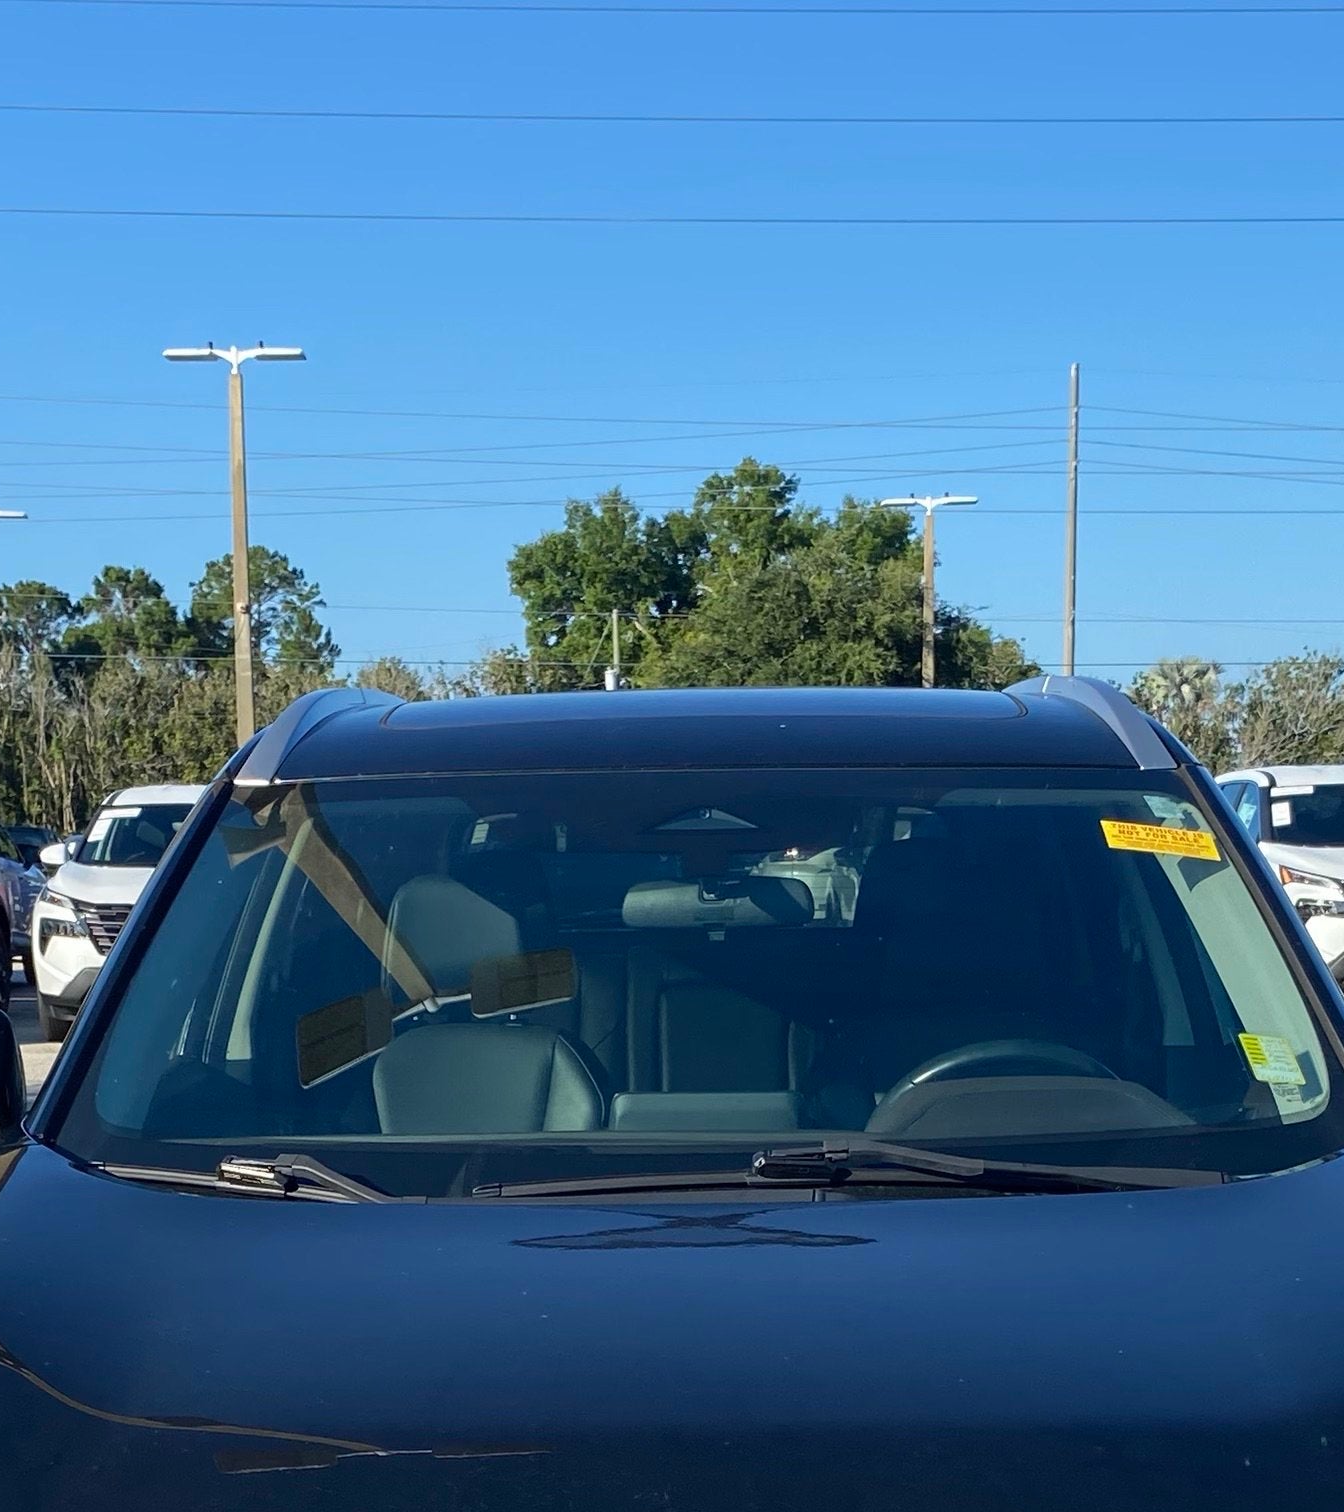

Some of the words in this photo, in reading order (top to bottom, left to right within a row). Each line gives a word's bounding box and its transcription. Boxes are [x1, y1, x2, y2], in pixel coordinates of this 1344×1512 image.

[1118, 829, 1141, 837] NOT
[1145, 832, 1168, 840] FOR
[1172, 836, 1201, 844] SALE
[1140, 826, 1189, 838] VEHICLE
